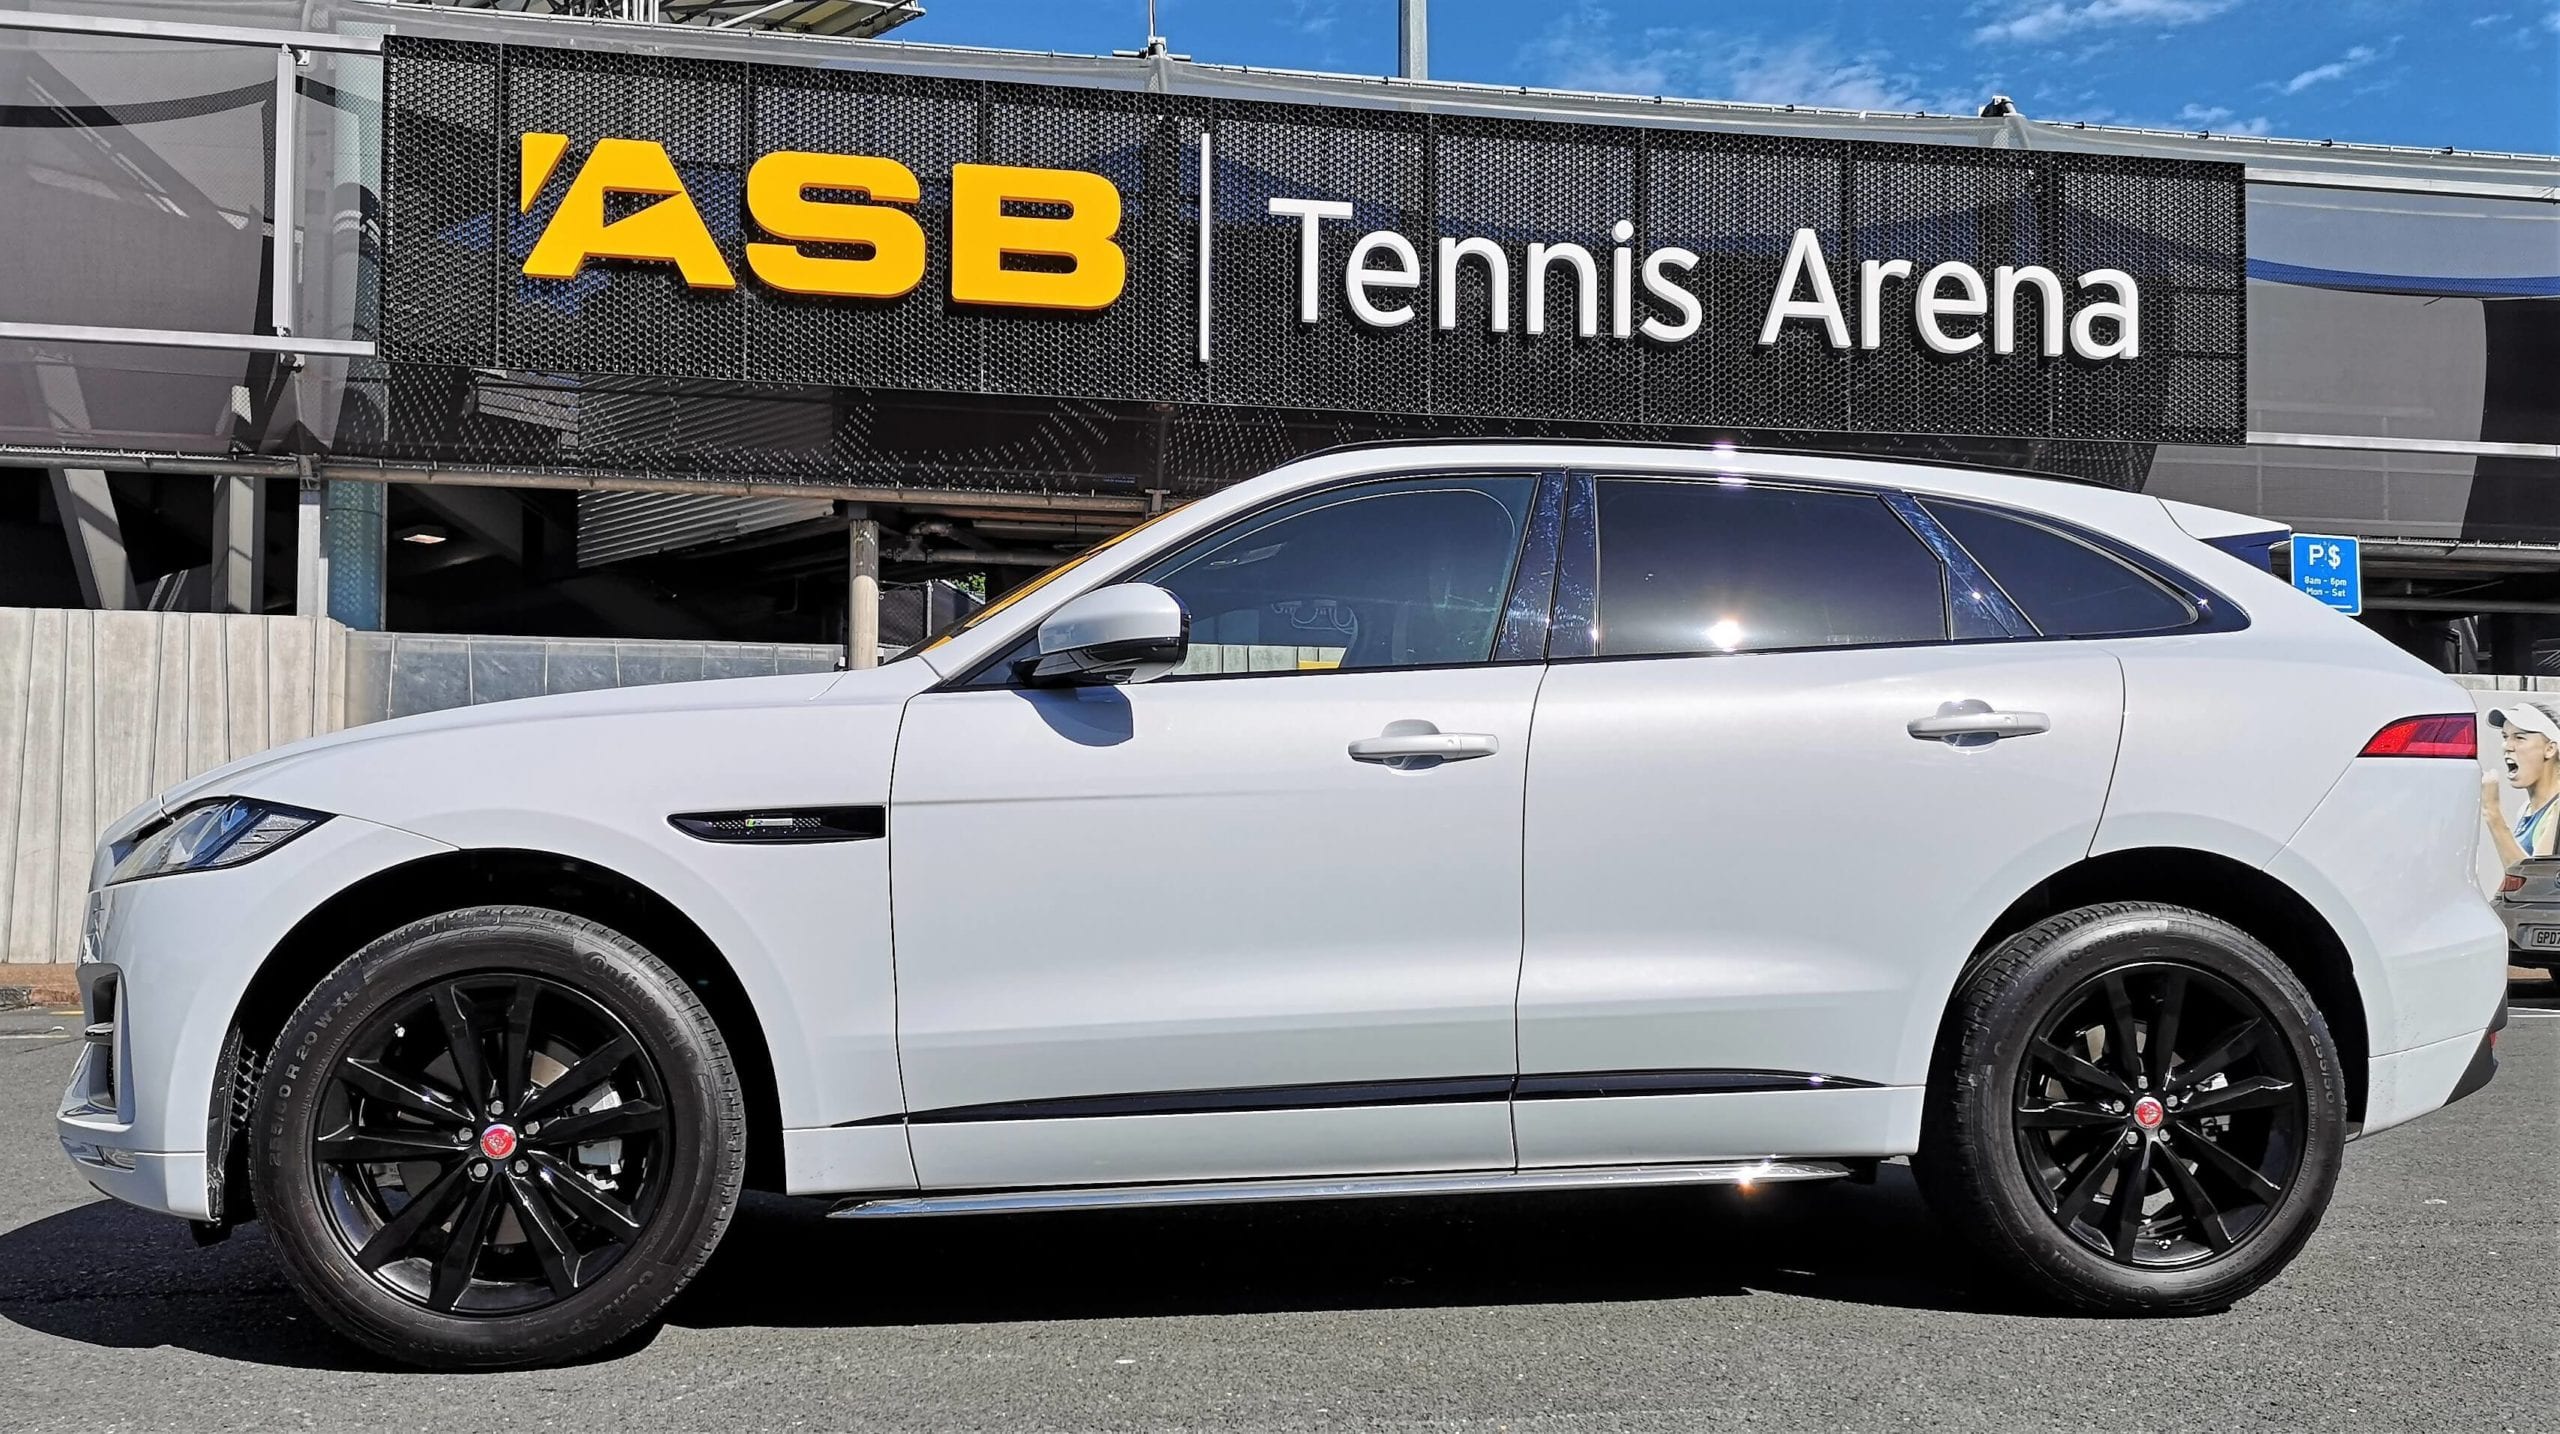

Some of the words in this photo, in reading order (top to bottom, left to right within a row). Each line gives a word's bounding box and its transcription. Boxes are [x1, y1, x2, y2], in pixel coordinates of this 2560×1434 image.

[521, 132, 1126, 311] ASB
[1268, 197, 1703, 343] Tennis
[1758, 228, 2140, 360] Arena
[2304, 575, 2322, 585] 8am
[2306, 586, 2323, 596] Mon
[2331, 588, 2346, 597] Sat
[285, 1063, 301, 1080] R
